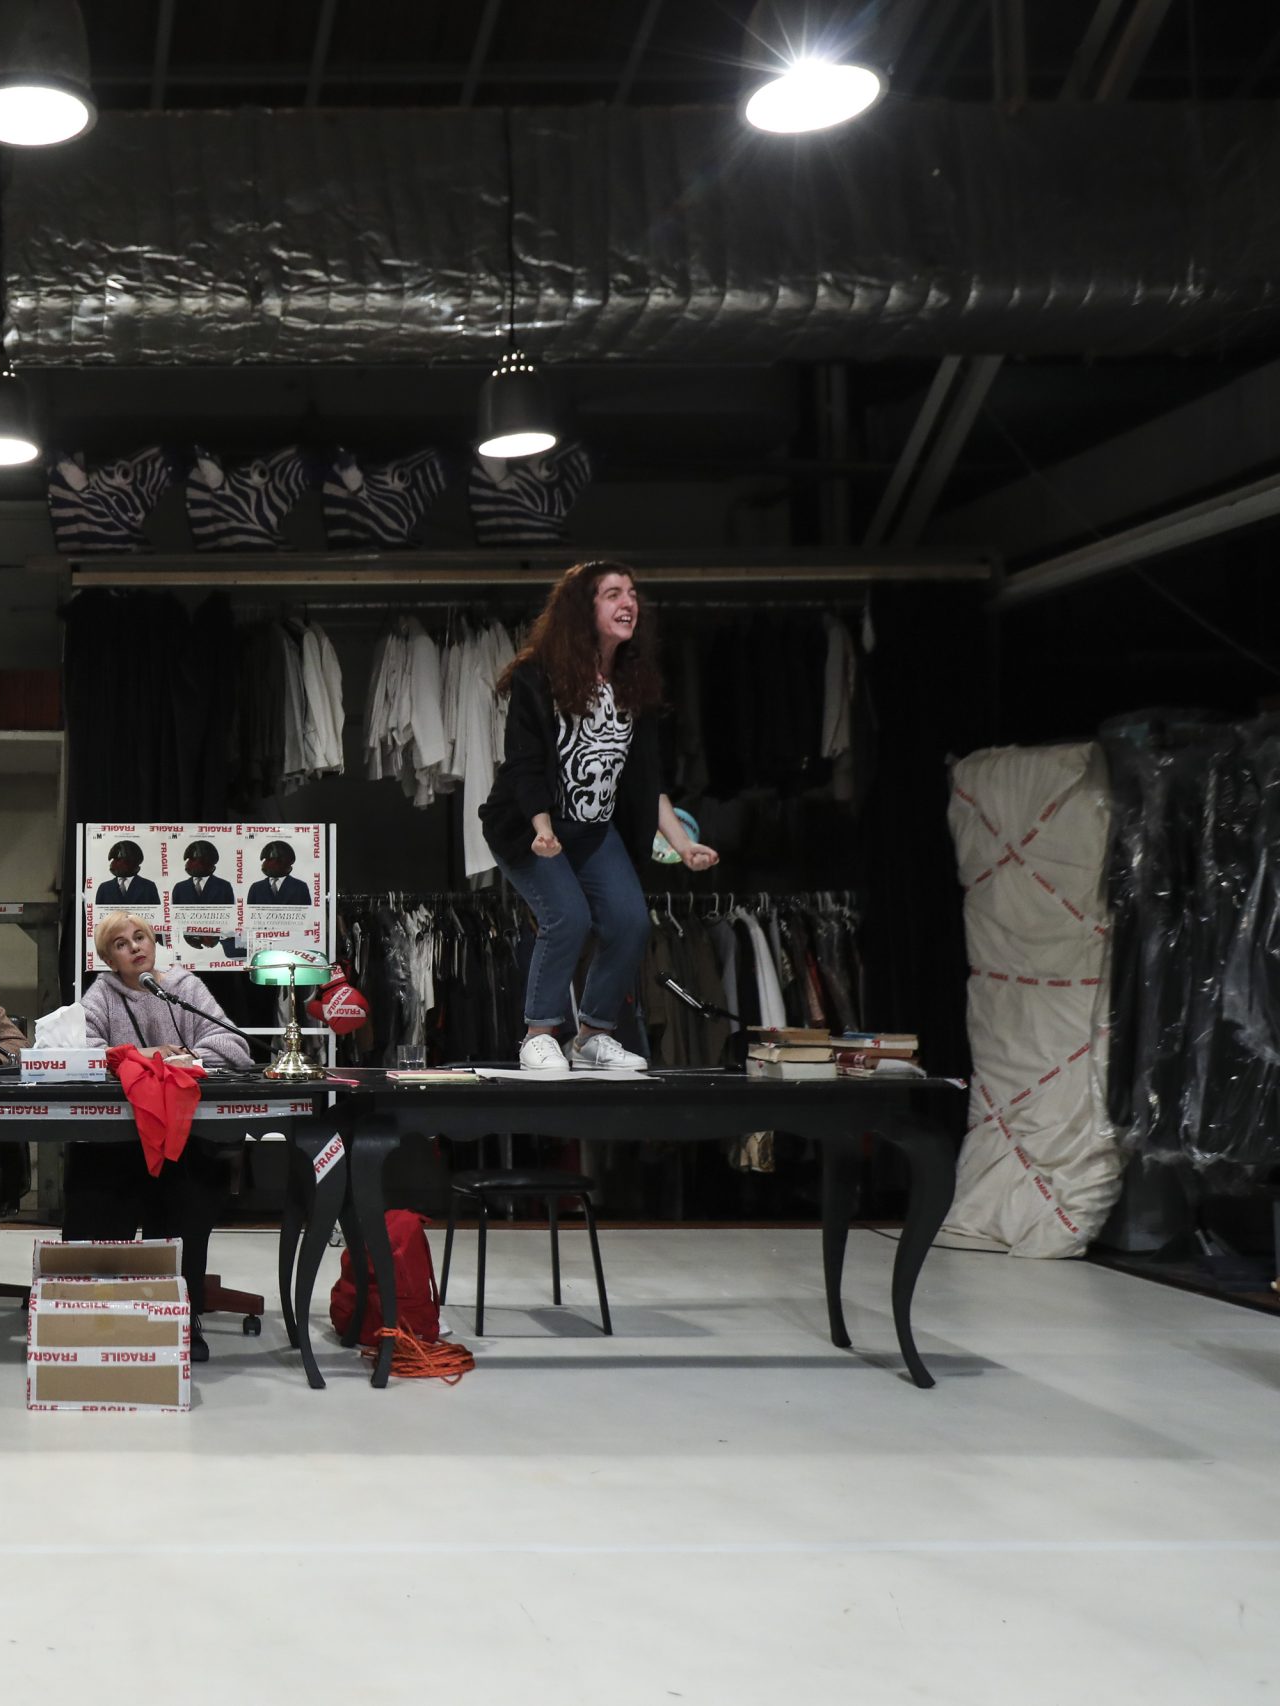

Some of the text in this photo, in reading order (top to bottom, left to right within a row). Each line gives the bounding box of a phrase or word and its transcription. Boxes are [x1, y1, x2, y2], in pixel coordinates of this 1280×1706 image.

[236, 848, 244, 884] FRAGILE
[313, 872, 321, 907] FRAGILE
[186, 926, 221, 934] FRAGILE
[209, 961, 244, 969] FRAGILE
[20, 1059, 66, 1070] FRAGIL
[69, 1105, 121, 1115] FRAGILE
[217, 1104, 269, 1114] FRAGILE
[289, 1102, 314, 1112] GILE
[314, 1137, 342, 1174] FRAGI
[148, 1305, 191, 1316] FRAGIL
[101, 1352, 156, 1362] FRAGILE
